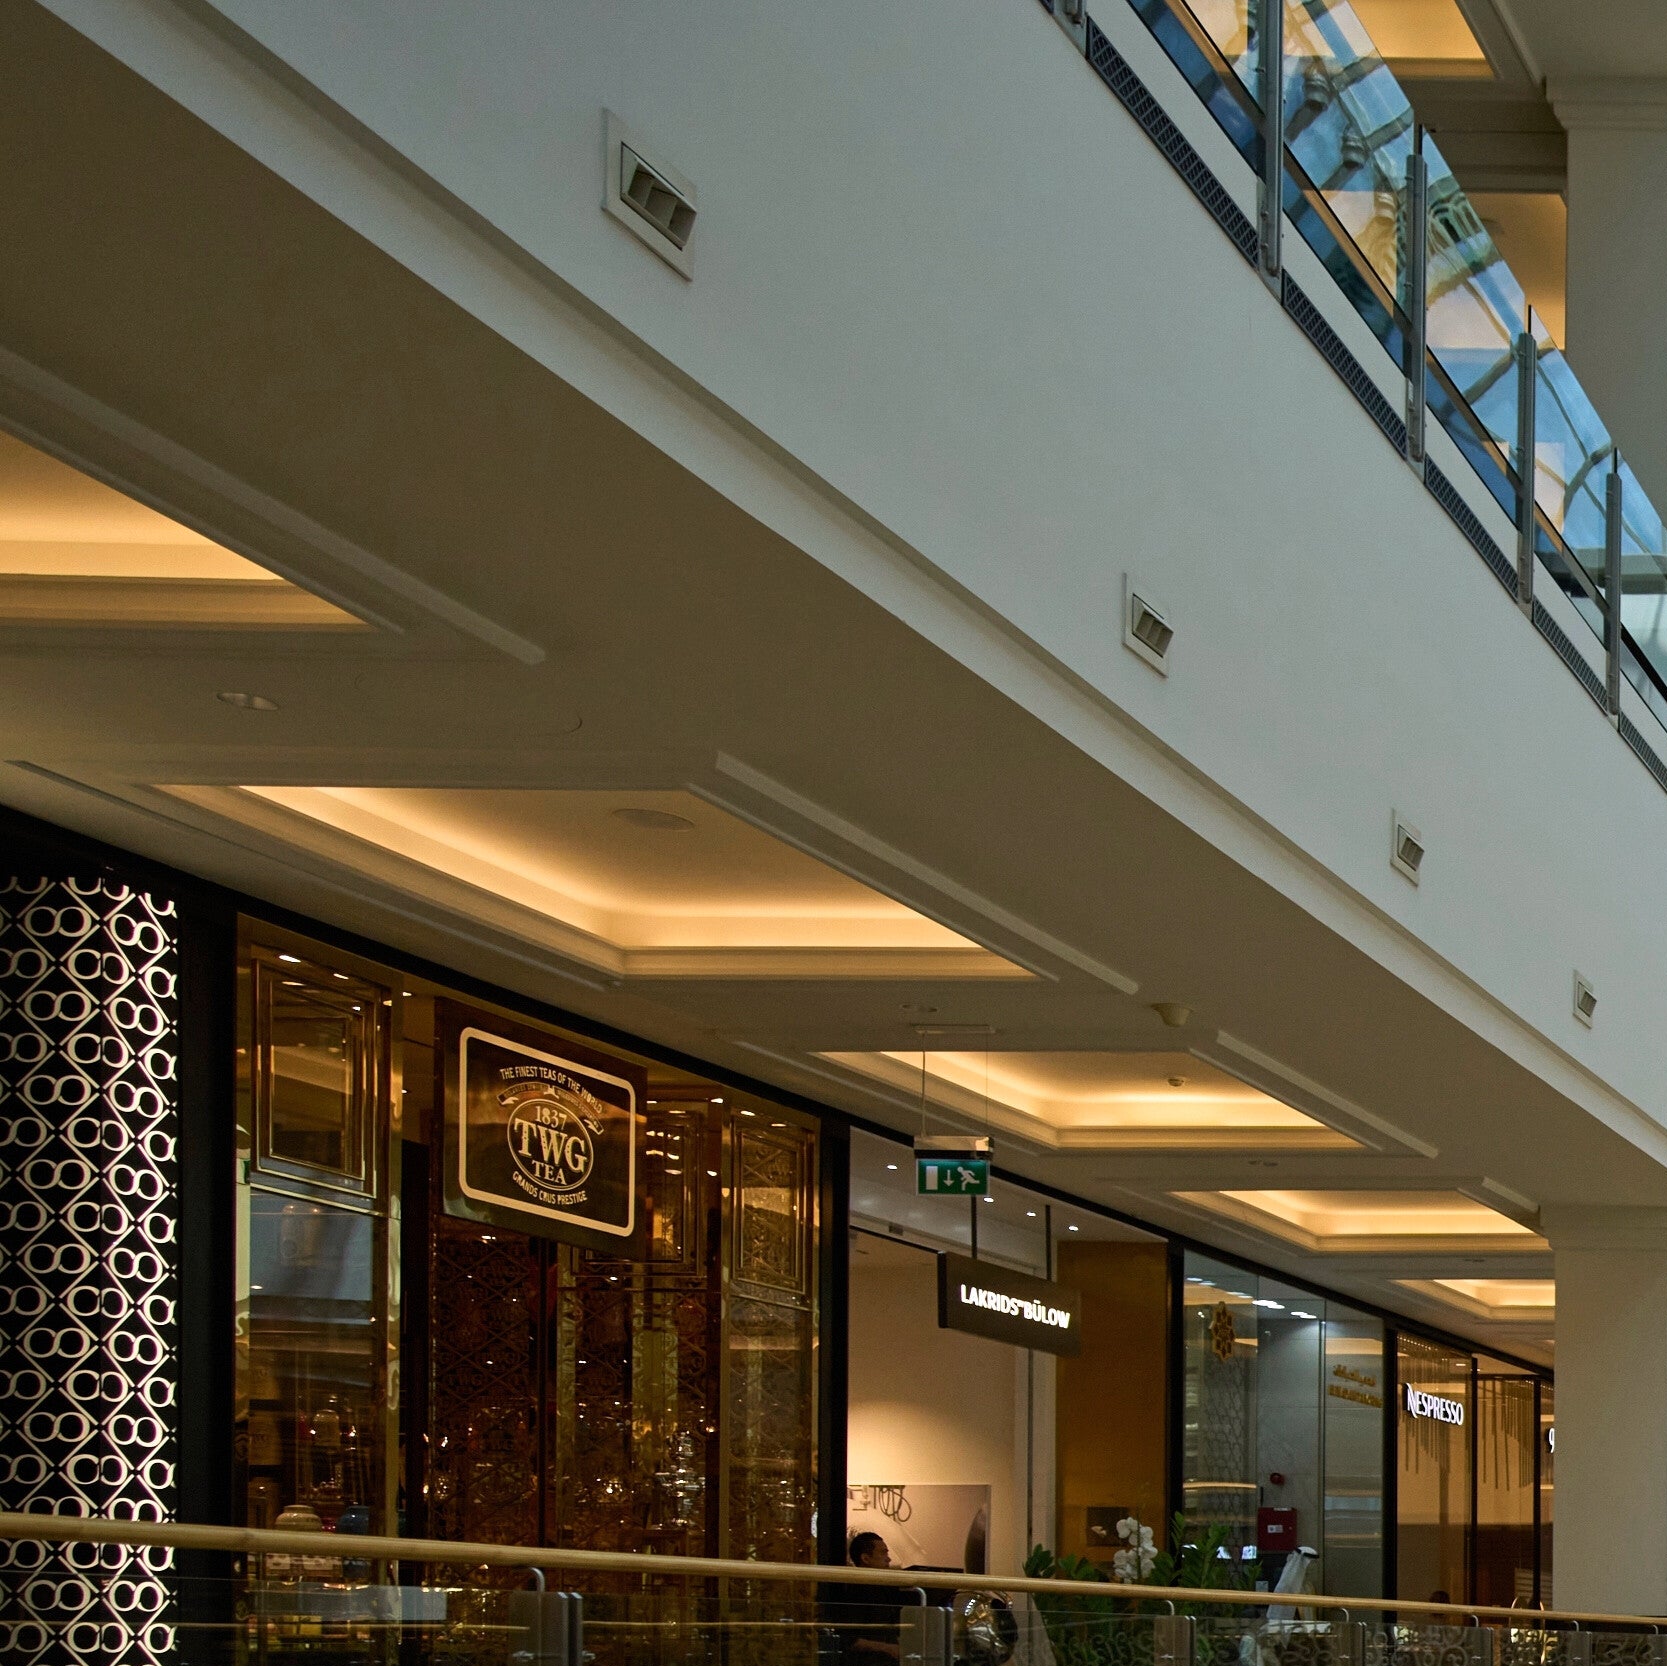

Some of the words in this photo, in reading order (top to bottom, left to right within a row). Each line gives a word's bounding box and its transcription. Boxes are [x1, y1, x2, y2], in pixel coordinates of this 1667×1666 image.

[500, 1067, 515, 1081] THE
[515, 1066, 539, 1079] FINEST
[539, 1067, 558, 1082] TEAS
[557, 1072, 568, 1084] OF
[567, 1076, 582, 1094] THE
[581, 1086, 604, 1115] WORLD
[535, 1105, 568, 1131] 1837
[514, 1117, 588, 1174] TWG
[512, 1170, 539, 1198] GRANDS
[538, 1191, 557, 1205] CRUS
[557, 1189, 588, 1206] PRESTIGE
[532, 1159, 568, 1186] TEA
[961, 1284, 1019, 1316] LAKRIDS
[1405, 1382, 1464, 1426] NESPRESSO
